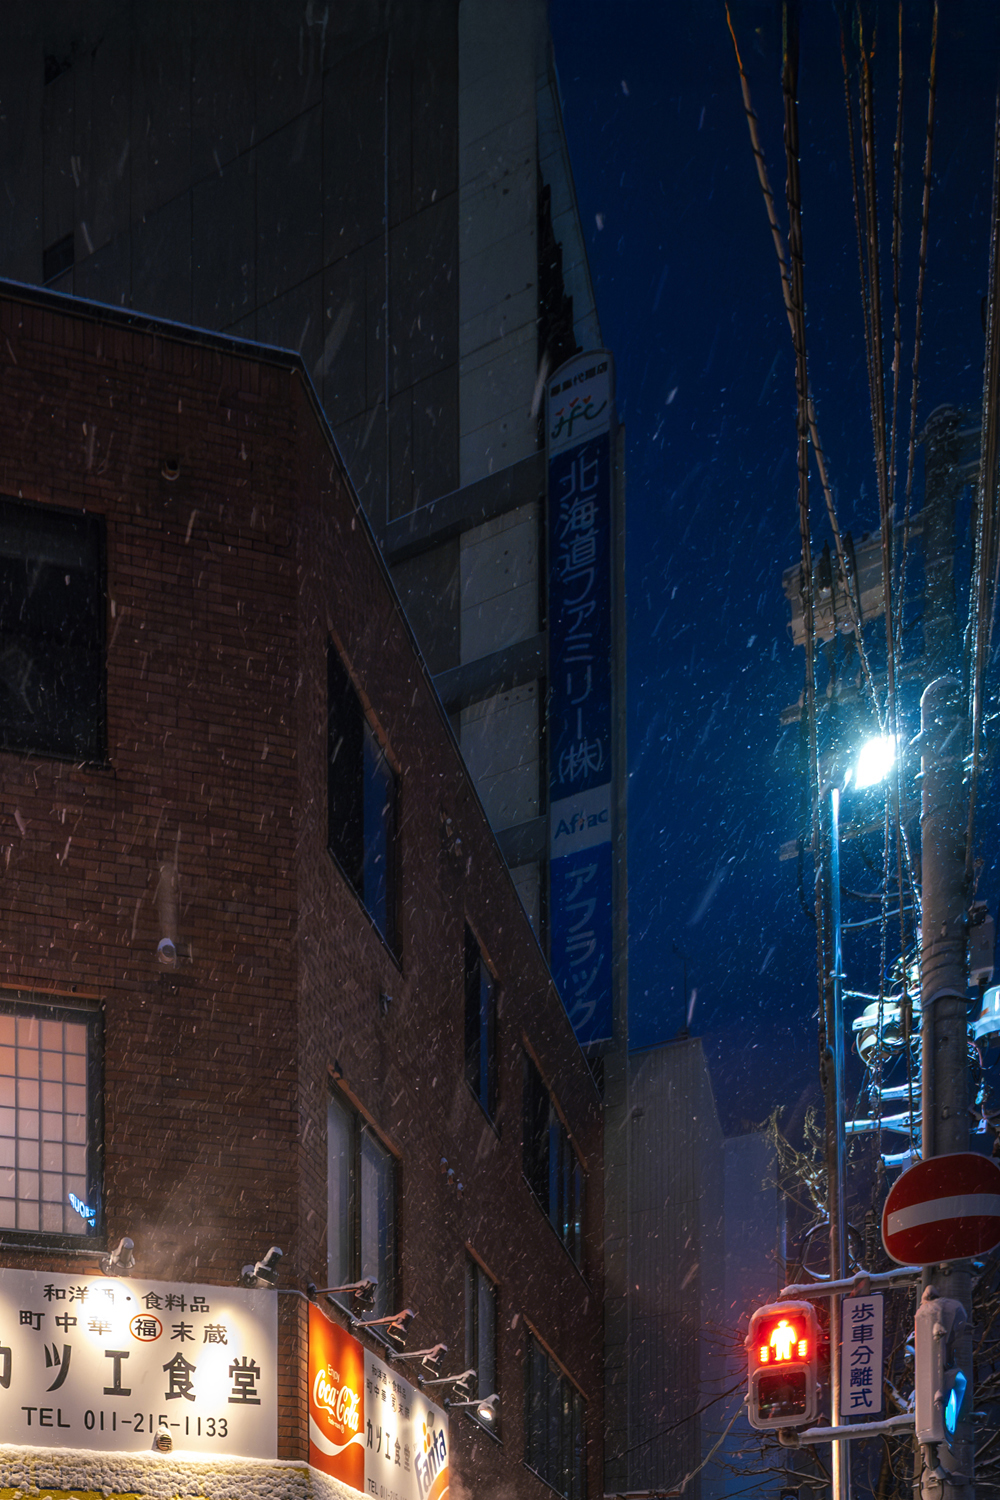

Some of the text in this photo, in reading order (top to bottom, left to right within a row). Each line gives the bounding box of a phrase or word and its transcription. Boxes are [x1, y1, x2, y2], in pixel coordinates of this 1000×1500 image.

[565, 864, 604, 1031] アフラック
[849, 1303, 875, 1408] 歩車分離式
[21, 1406, 229, 1438] TEL 011-215-1133
[313, 1369, 361, 1432] Coca-Cola
[367, 1477, 379, 1495] TEL
